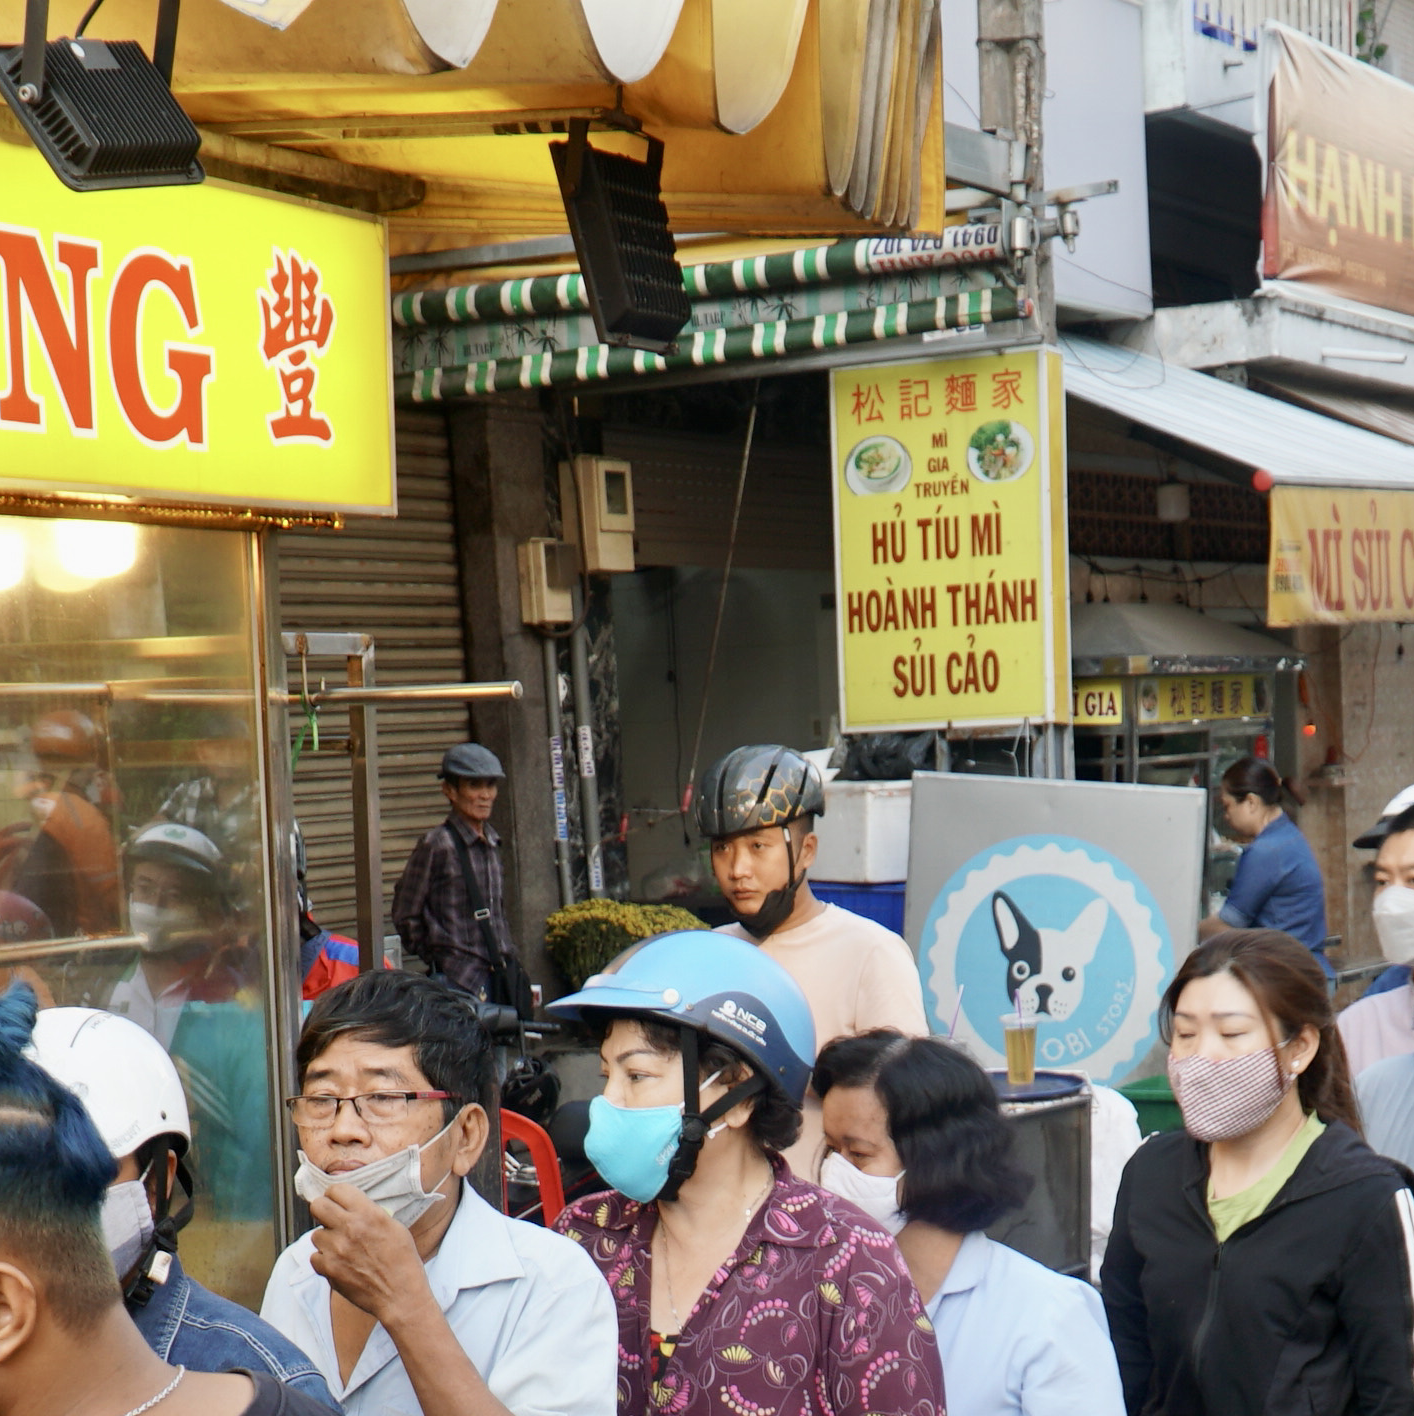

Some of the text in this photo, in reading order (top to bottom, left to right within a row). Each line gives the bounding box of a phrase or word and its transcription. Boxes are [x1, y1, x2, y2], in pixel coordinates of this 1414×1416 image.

[258, 248, 335, 447] 豐
[851, 368, 1024, 425] 松記麵家
[927, 457, 949, 473] GIA
[932, 429, 948, 449] MÌ
[872, 500, 1003, 565] HỦ TÍU MÌ
[1308, 502, 1346, 611] MÌ
[1351, 499, 1394, 612] SỦI
[847, 569, 1038, 634] HOÀNH THÁNH
[893, 633, 1000, 698] SỦI CẢO
[1085, 691, 1118, 717] GIA
[736, 1007, 767, 1032] NCB
